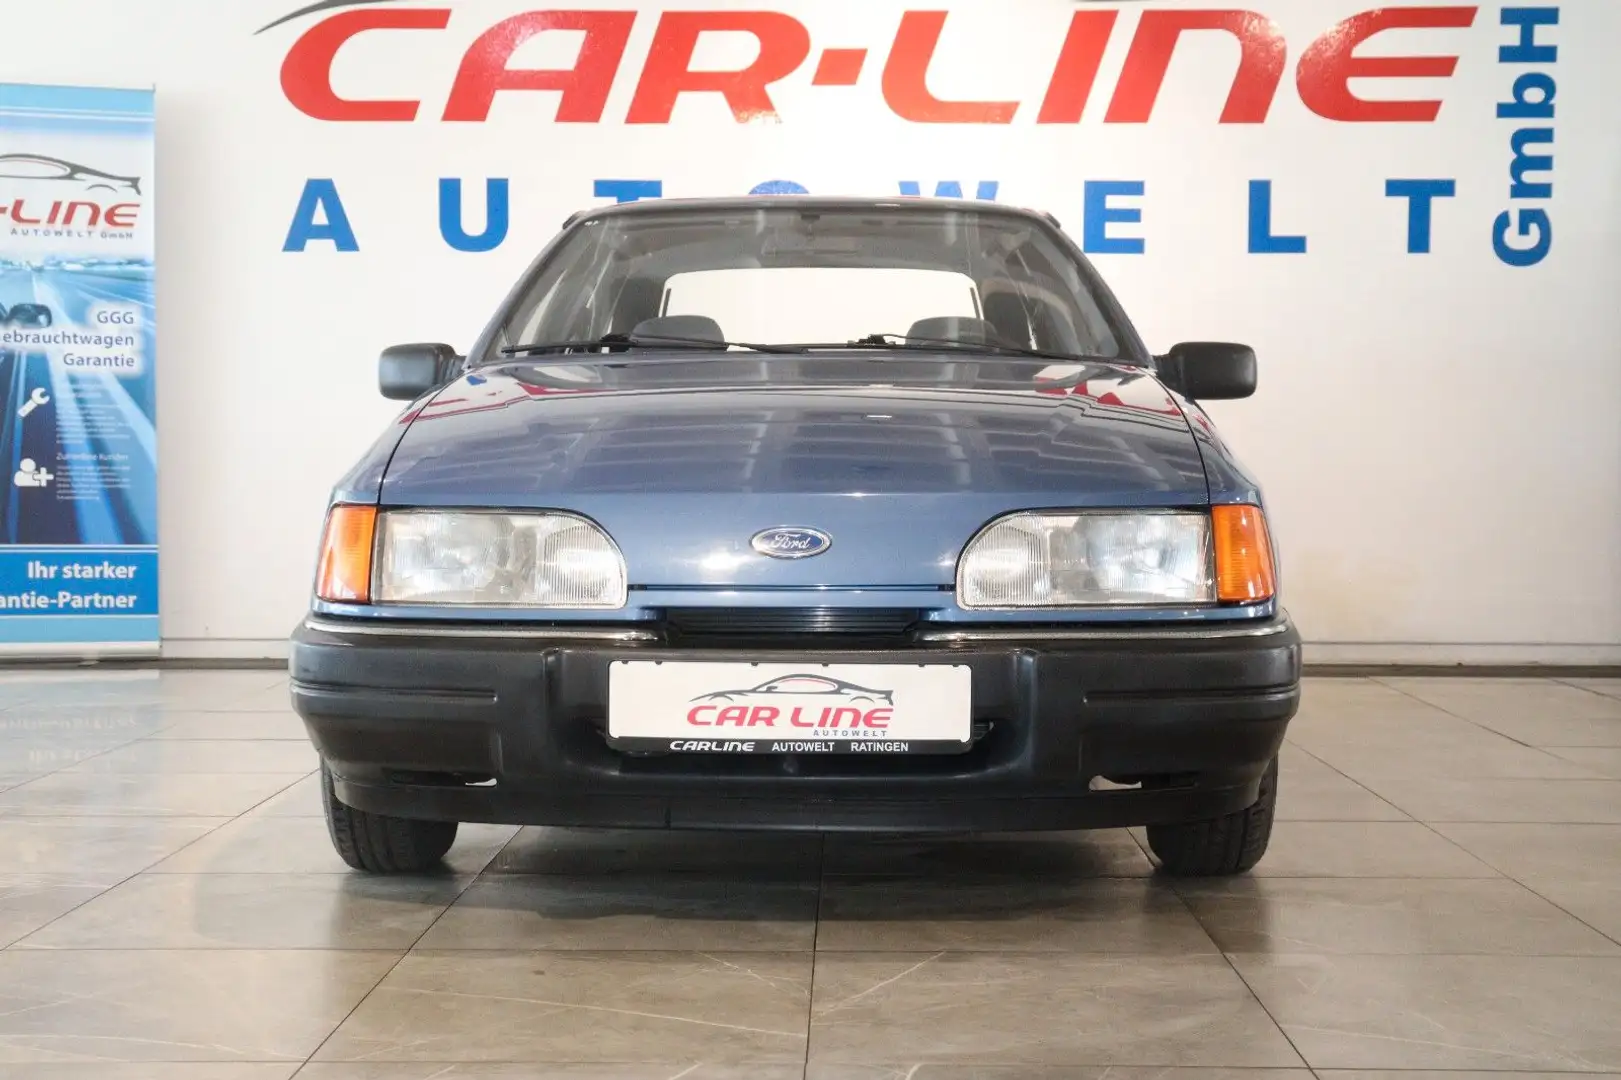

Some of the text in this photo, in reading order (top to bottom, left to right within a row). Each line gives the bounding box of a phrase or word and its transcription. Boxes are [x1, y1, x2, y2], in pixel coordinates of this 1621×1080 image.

[280, 6, 1478, 125] CAR-LINE
[1492, 7, 1559, 267] GmbH
[282, 178, 1456, 253] AUELT
[10, 228, 92, 238] AUTOWELT
[97, 310, 134, 324] GGG
[63, 353, 135, 367] Garantie
[770, 533, 811, 549] Ford
[27, 560, 137, 579] Ihr starker
[686, 705, 894, 728] CAR LINE
[813, 729, 887, 737] AUTOWELT
[669, 740, 909, 752] CARLINE AUTOWELT RATINGEN
